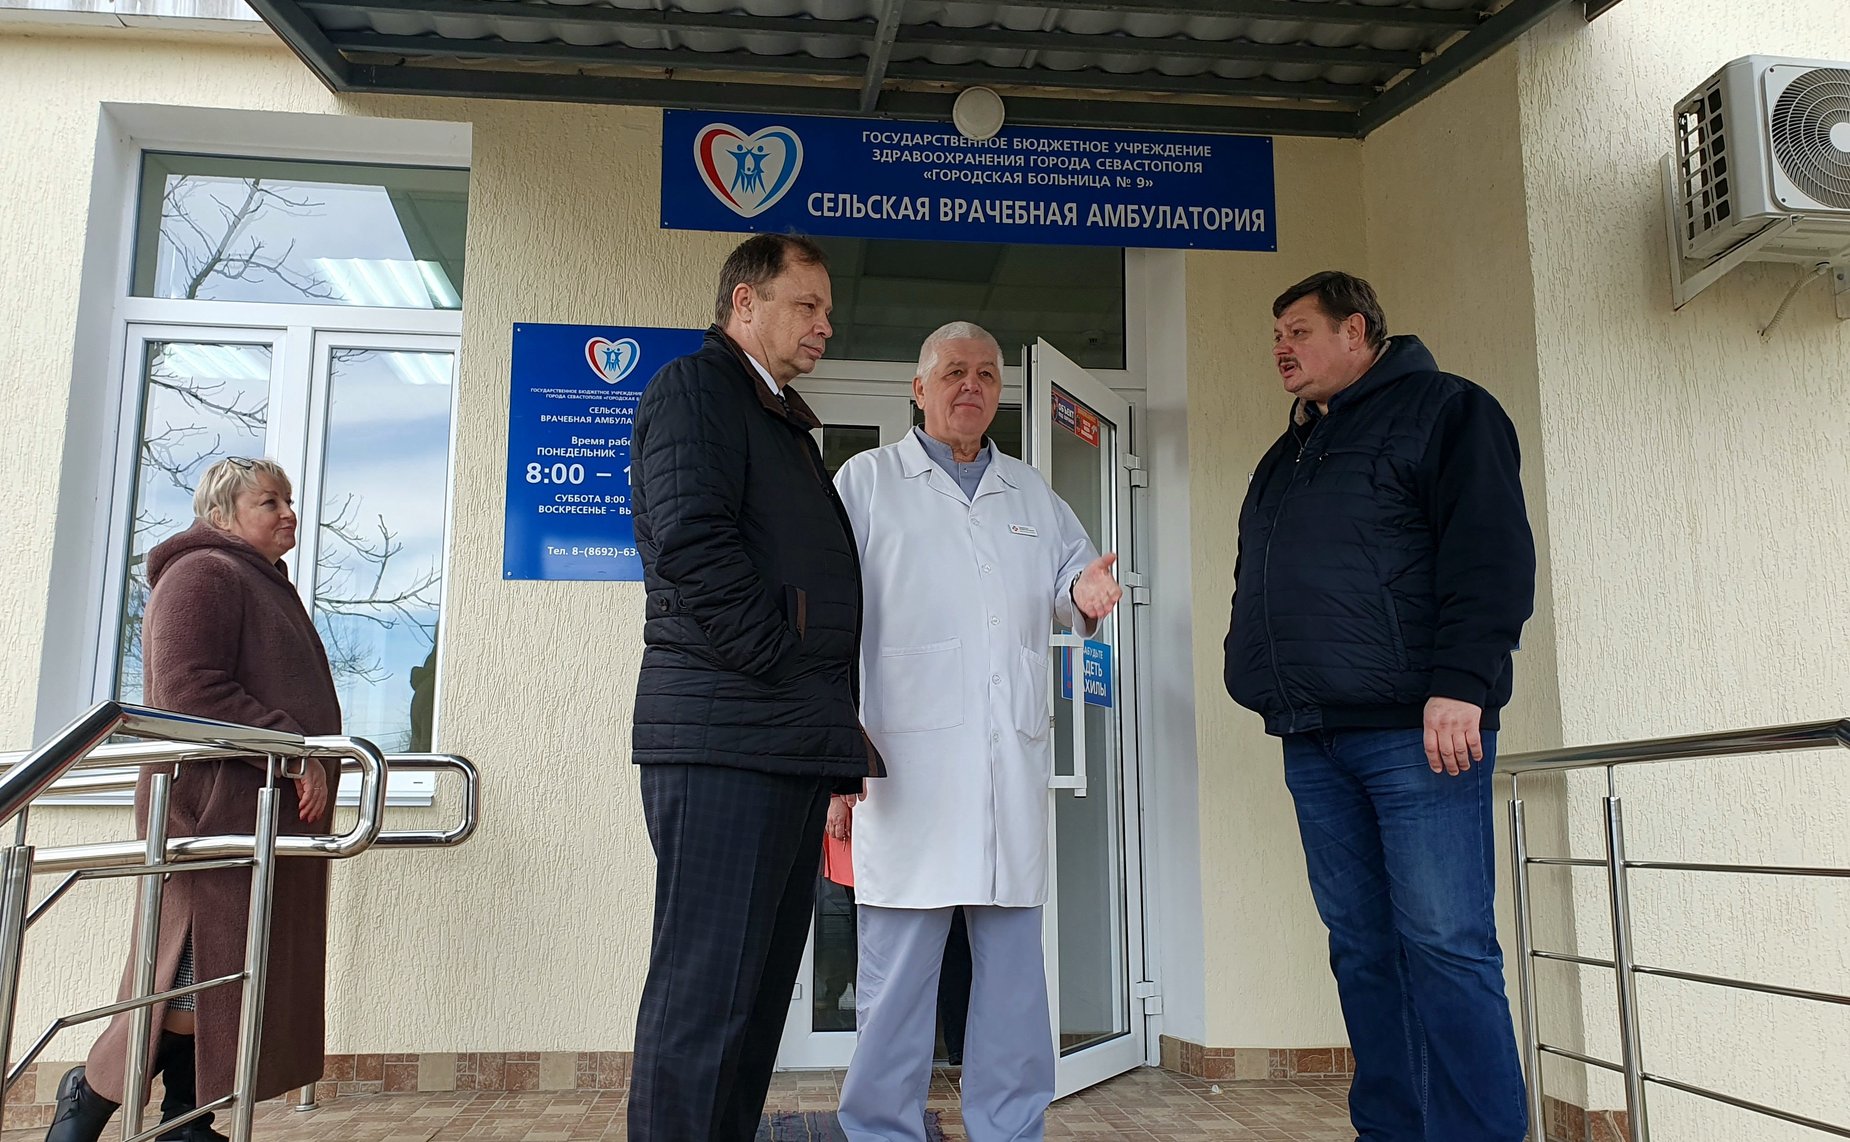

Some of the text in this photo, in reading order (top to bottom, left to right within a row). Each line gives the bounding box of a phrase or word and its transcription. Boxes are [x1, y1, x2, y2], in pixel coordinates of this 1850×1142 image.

[862, 131, 1212, 157] ГОСУДАРСТВЕННОЕ БЮДЖЕТНОЕ УЧРЕЖДЕНИЕ
[872, 149, 1203, 174] ЗДРАВООХРАНЕНИЯ ГОРОДА СЕВАСТОПОЛЯ
[923, 169, 1154, 188] «ГОРОДСКАЯ БОЛЬНИЦА № 9»
[807, 192, 1265, 232] СЕЛЬСКАЯ ВРАЧЕБНАЯ АМБУЛАТОРИЯ
[589, 406, 633, 415] СЕЛЬСКАЯ
[540, 414, 633, 425] ВРАЧЕБНАЯ АМБУЛА
[571, 436, 605, 447] Время
[537, 447, 616, 458] ПОНЕДЕЛЬНИК
[526, 462, 585, 485] 8:00
[623, 465, 632, 486] 1
[555, 494, 625, 504] СУББОТА 8:00
[538, 505, 607, 515] ВОСКРЕСЕНЬЕ
[547, 546, 568, 556] Тел.
[1083, 645, 1104, 660] АБУДЬТЕ
[1084, 659, 1104, 677] ДЕТЬ
[1084, 678, 1107, 697] ХИЛЫ
